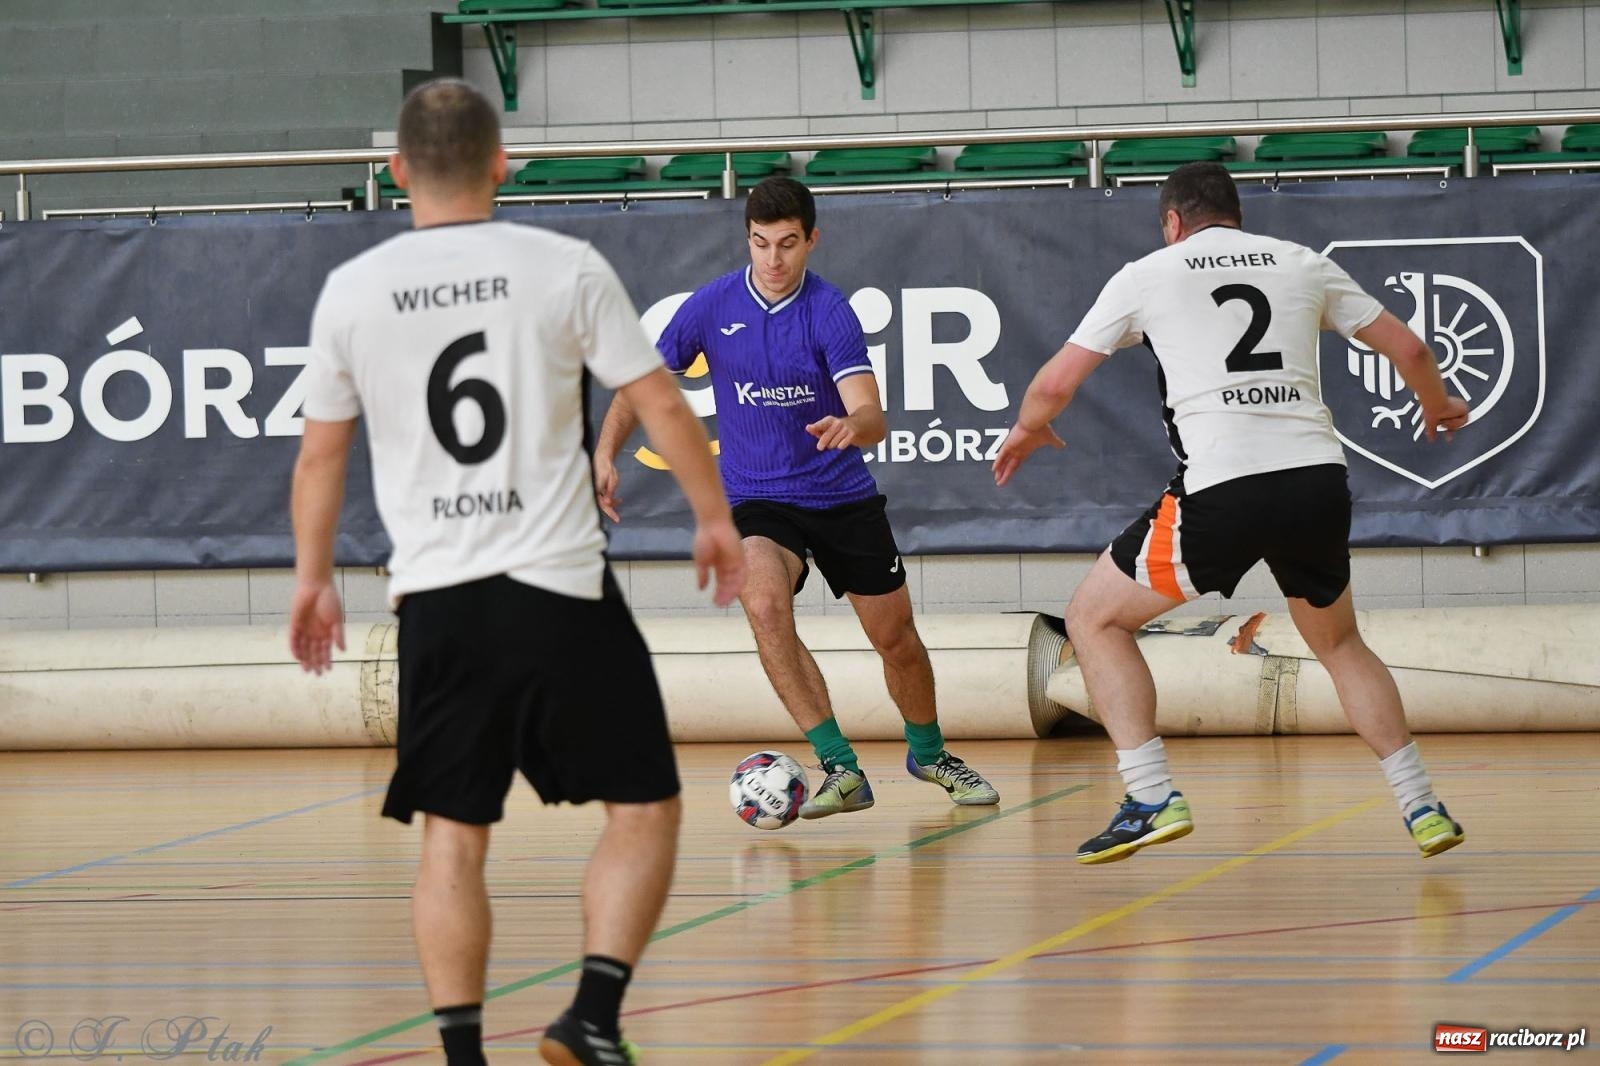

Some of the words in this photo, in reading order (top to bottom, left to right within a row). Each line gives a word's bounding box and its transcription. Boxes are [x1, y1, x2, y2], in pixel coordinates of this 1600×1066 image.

[1184, 252, 1277, 270] WICHER
[392, 276, 509, 313] WICHER
[1210, 283, 1284, 373] 2
[426, 331, 507, 465] 6
[734, 381, 815, 406] K-INSTAL
[1222, 385, 1301, 405] PŁONIA
[863, 417, 1010, 463] IBÓRZ
